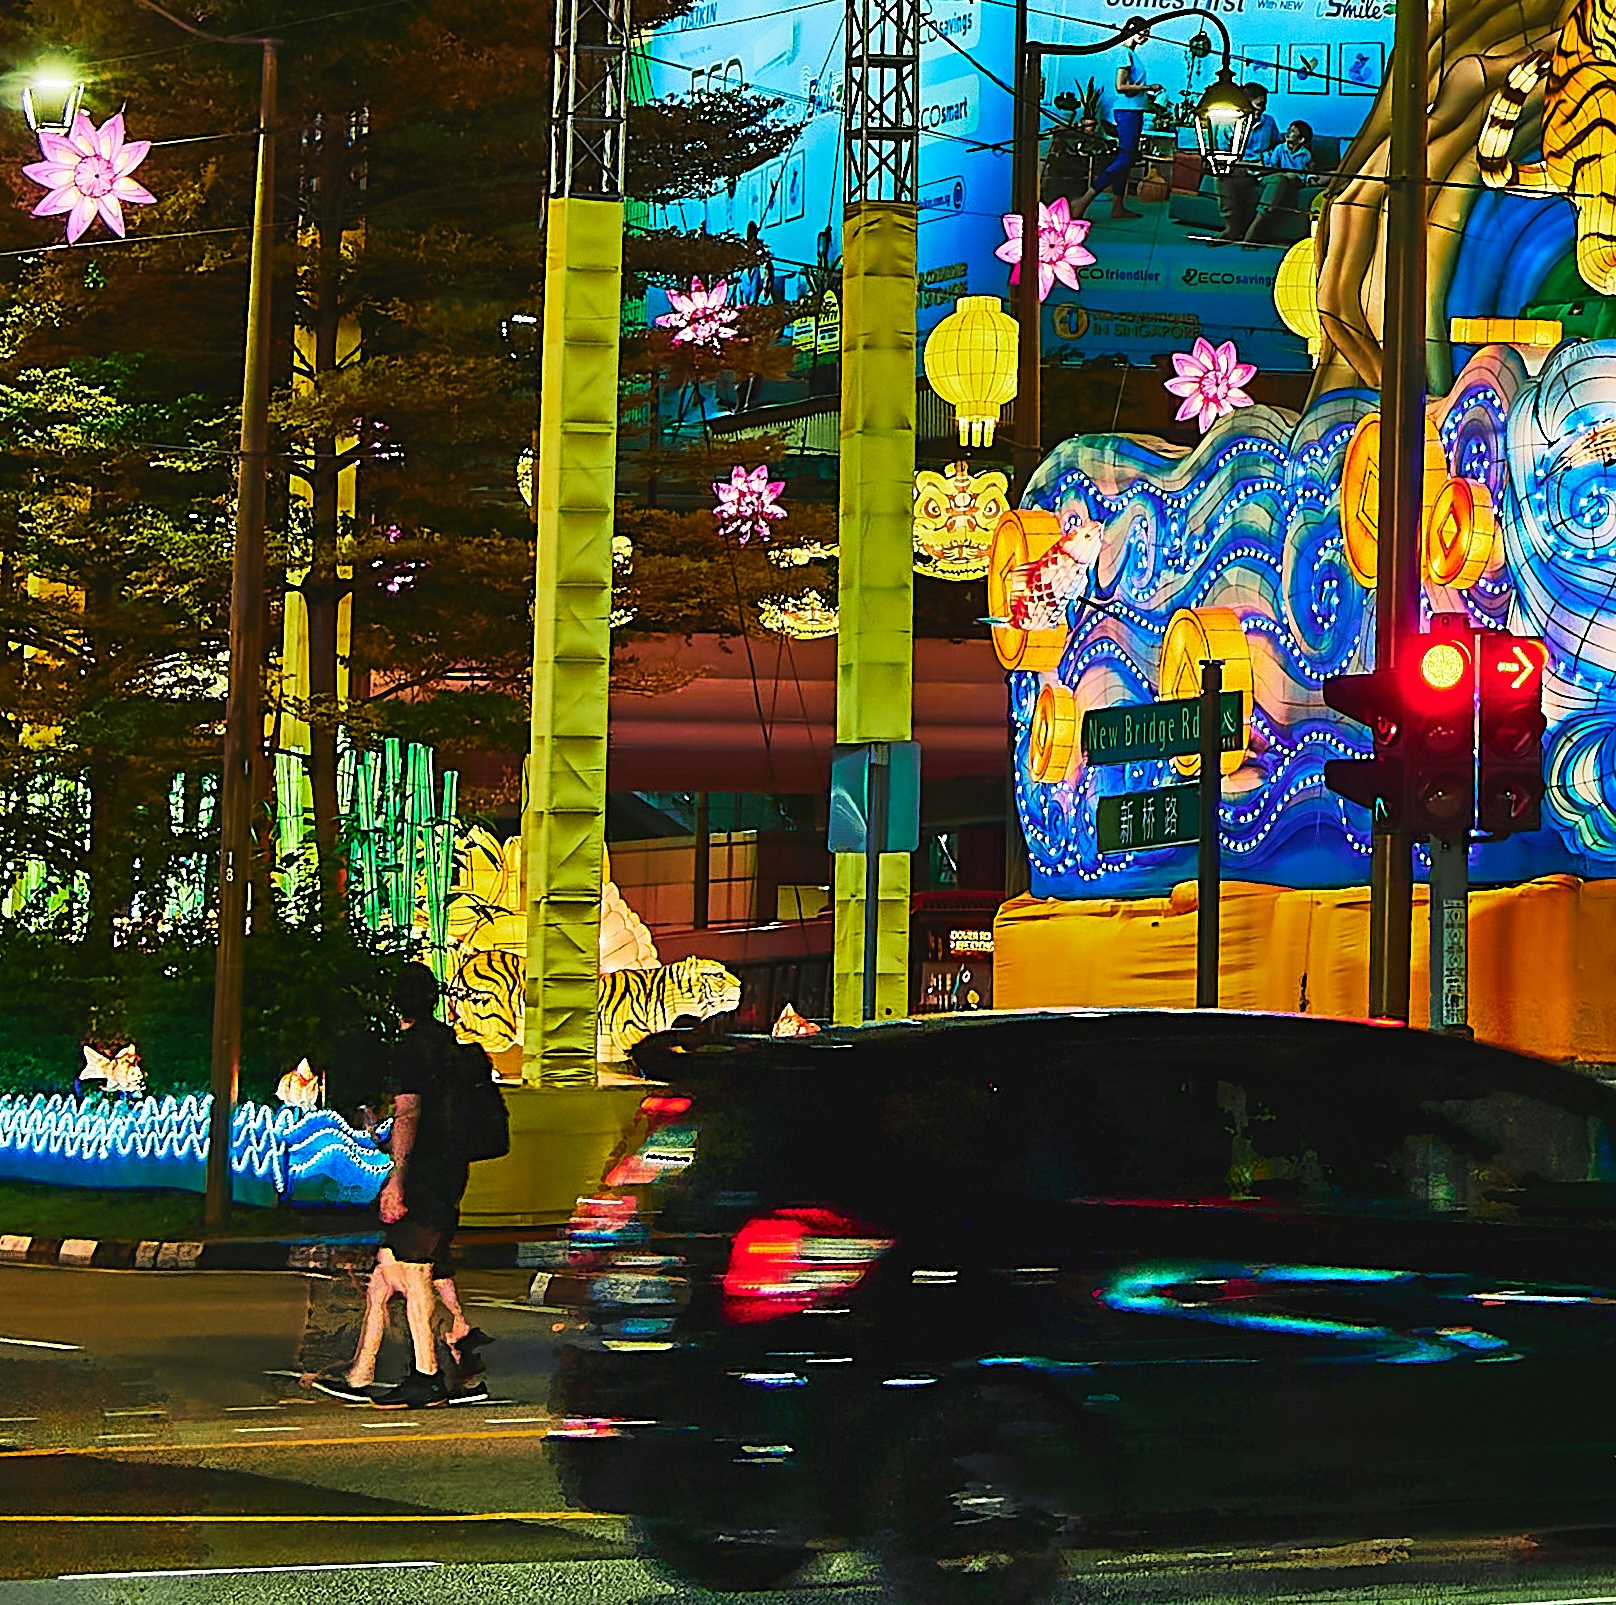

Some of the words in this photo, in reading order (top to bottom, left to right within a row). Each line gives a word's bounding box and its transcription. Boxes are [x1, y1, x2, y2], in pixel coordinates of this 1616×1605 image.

[1280, 0, 1303, 10] NEW
[920, 96, 968, 130] COsmart
[1078, 268, 1160, 282] COfriendlier
[1088, 719, 1118, 750] New
[1125, 712, 1175, 752] Bridge
[1182, 705, 1200, 740] Rd
[1120, 794, 1177, 845] 新桥路
